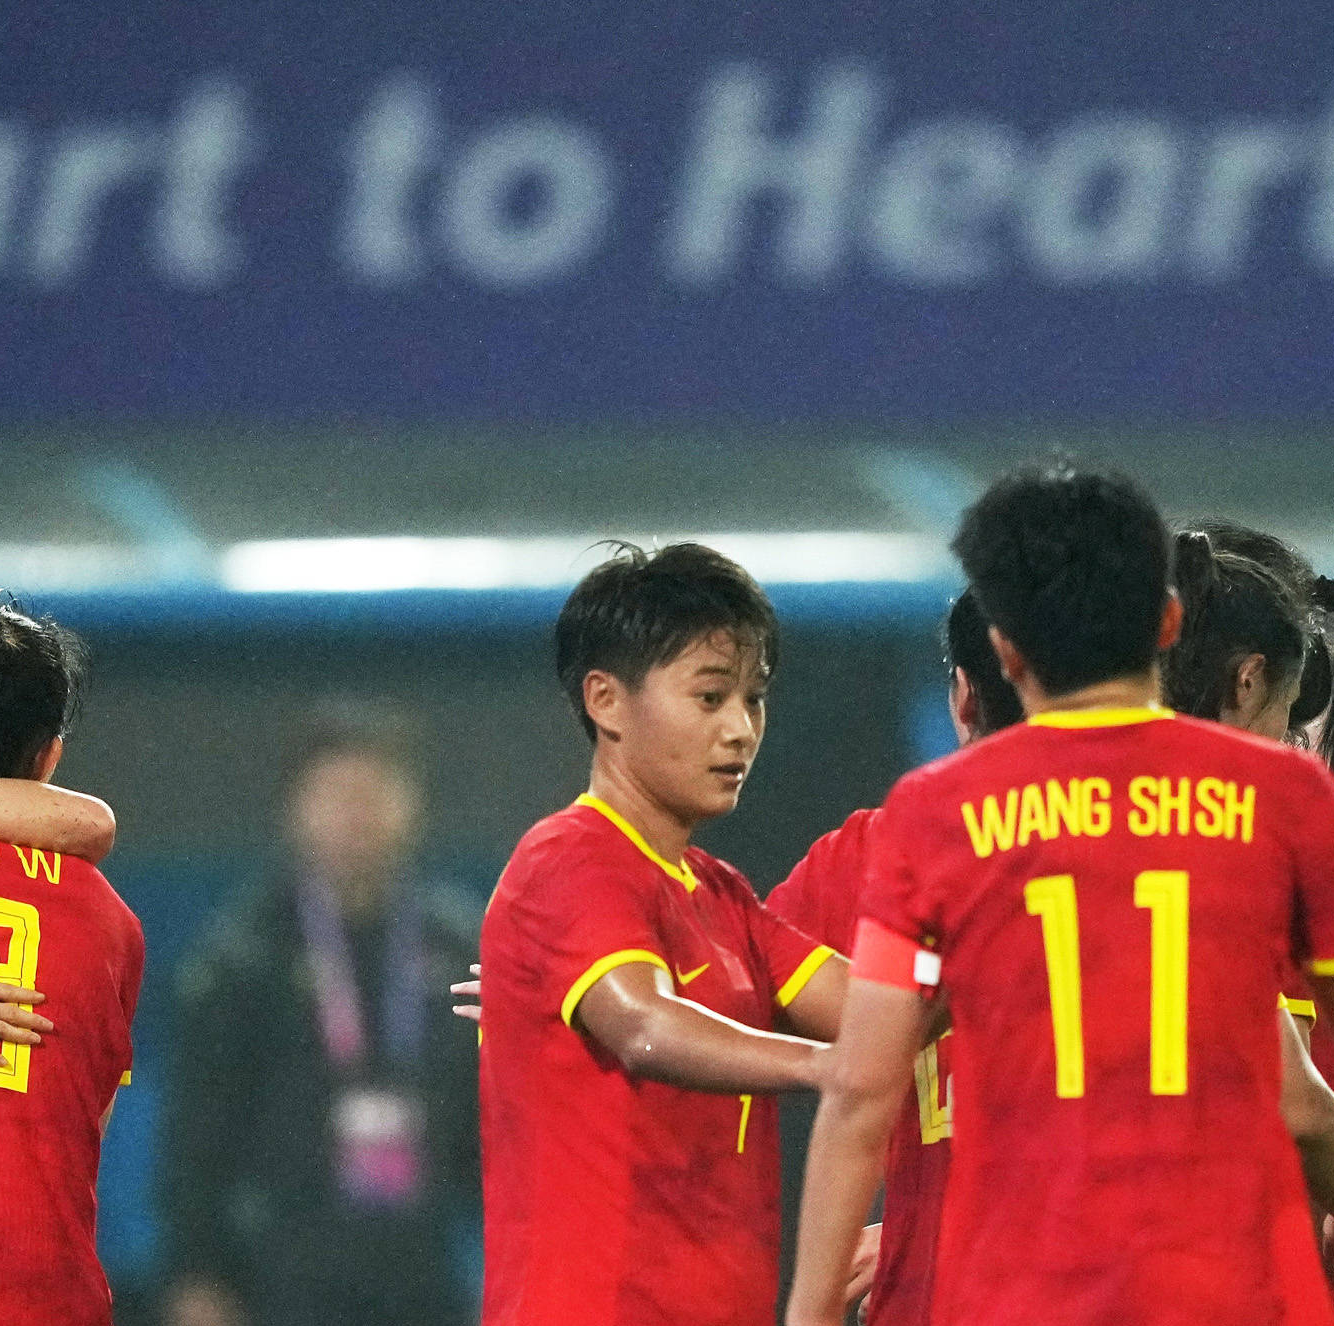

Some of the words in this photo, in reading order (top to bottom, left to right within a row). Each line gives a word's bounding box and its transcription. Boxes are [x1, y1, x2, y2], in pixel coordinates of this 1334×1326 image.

[338, 76, 617, 289] to
[961, 777, 1111, 858] WANG
[1024, 870, 1188, 1098] 11
